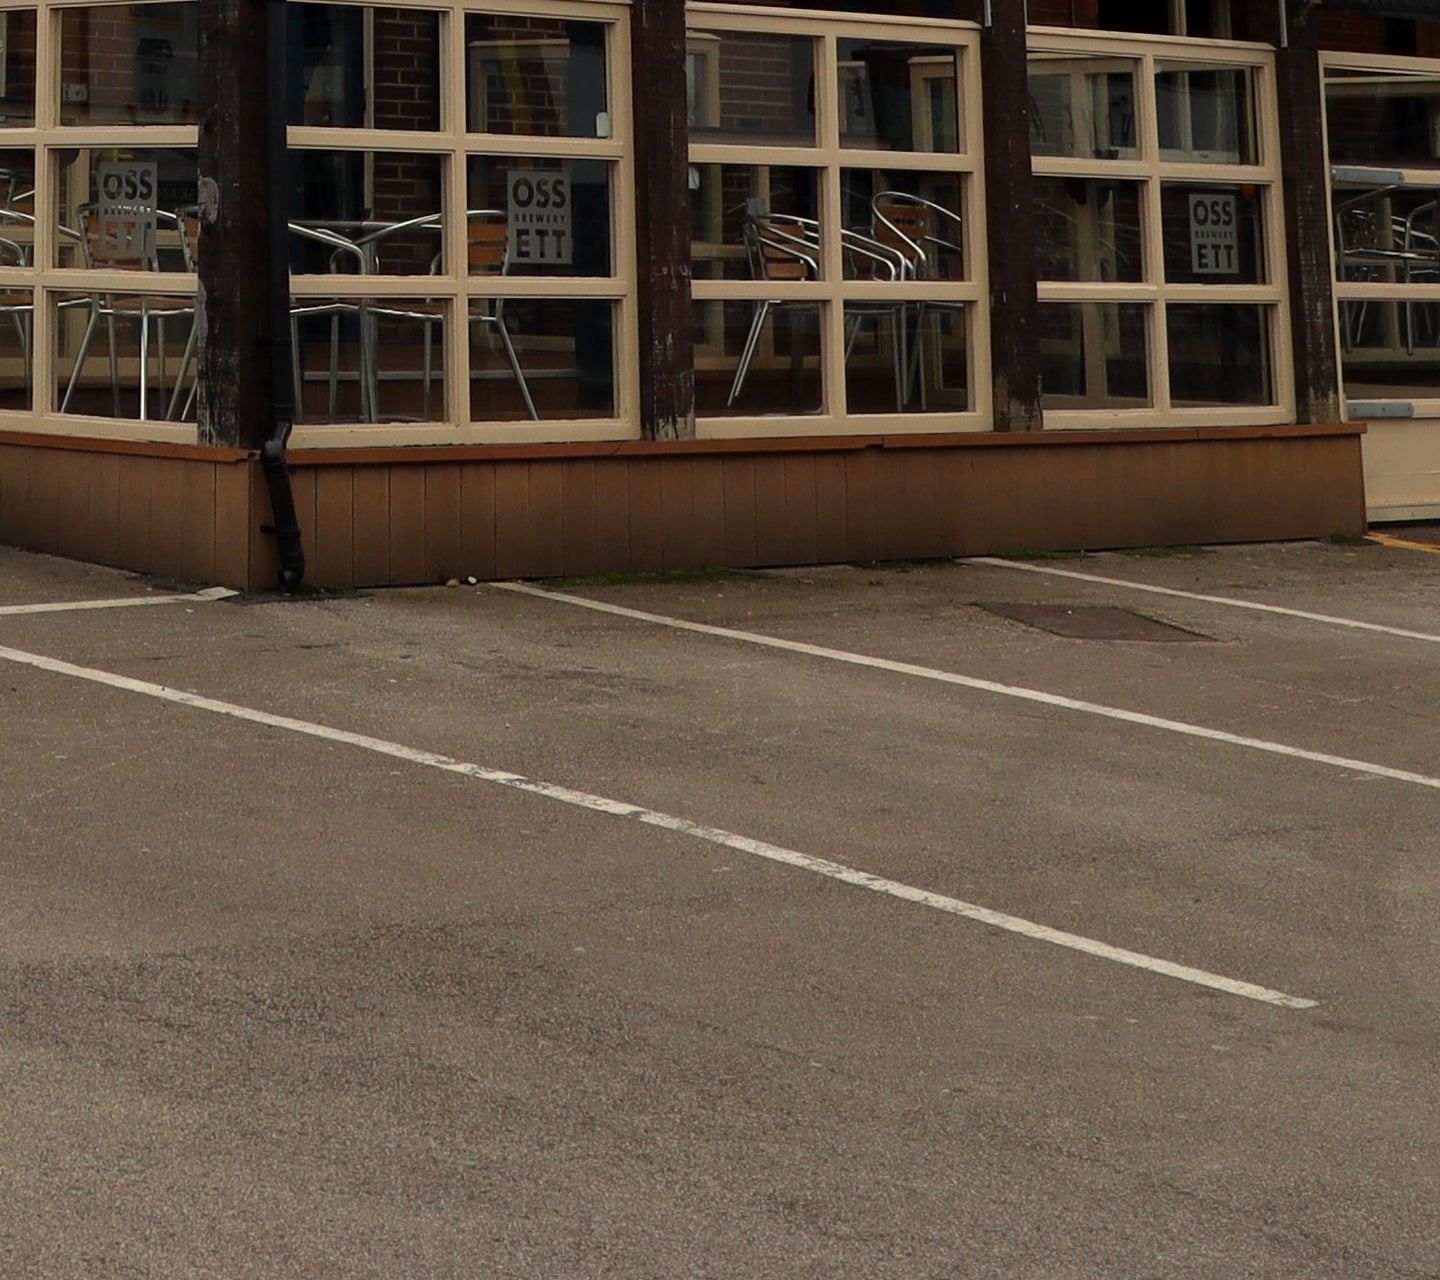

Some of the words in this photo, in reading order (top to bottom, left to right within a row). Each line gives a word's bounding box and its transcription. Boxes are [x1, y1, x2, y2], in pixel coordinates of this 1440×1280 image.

[103, 170, 153, 200] OSS
[512, 177, 566, 209] OSS
[514, 213, 565, 223] BREWERY
[1193, 200, 1233, 227] OSS
[516, 229, 566, 258] ETT
[1197, 244, 1234, 269] ETT
